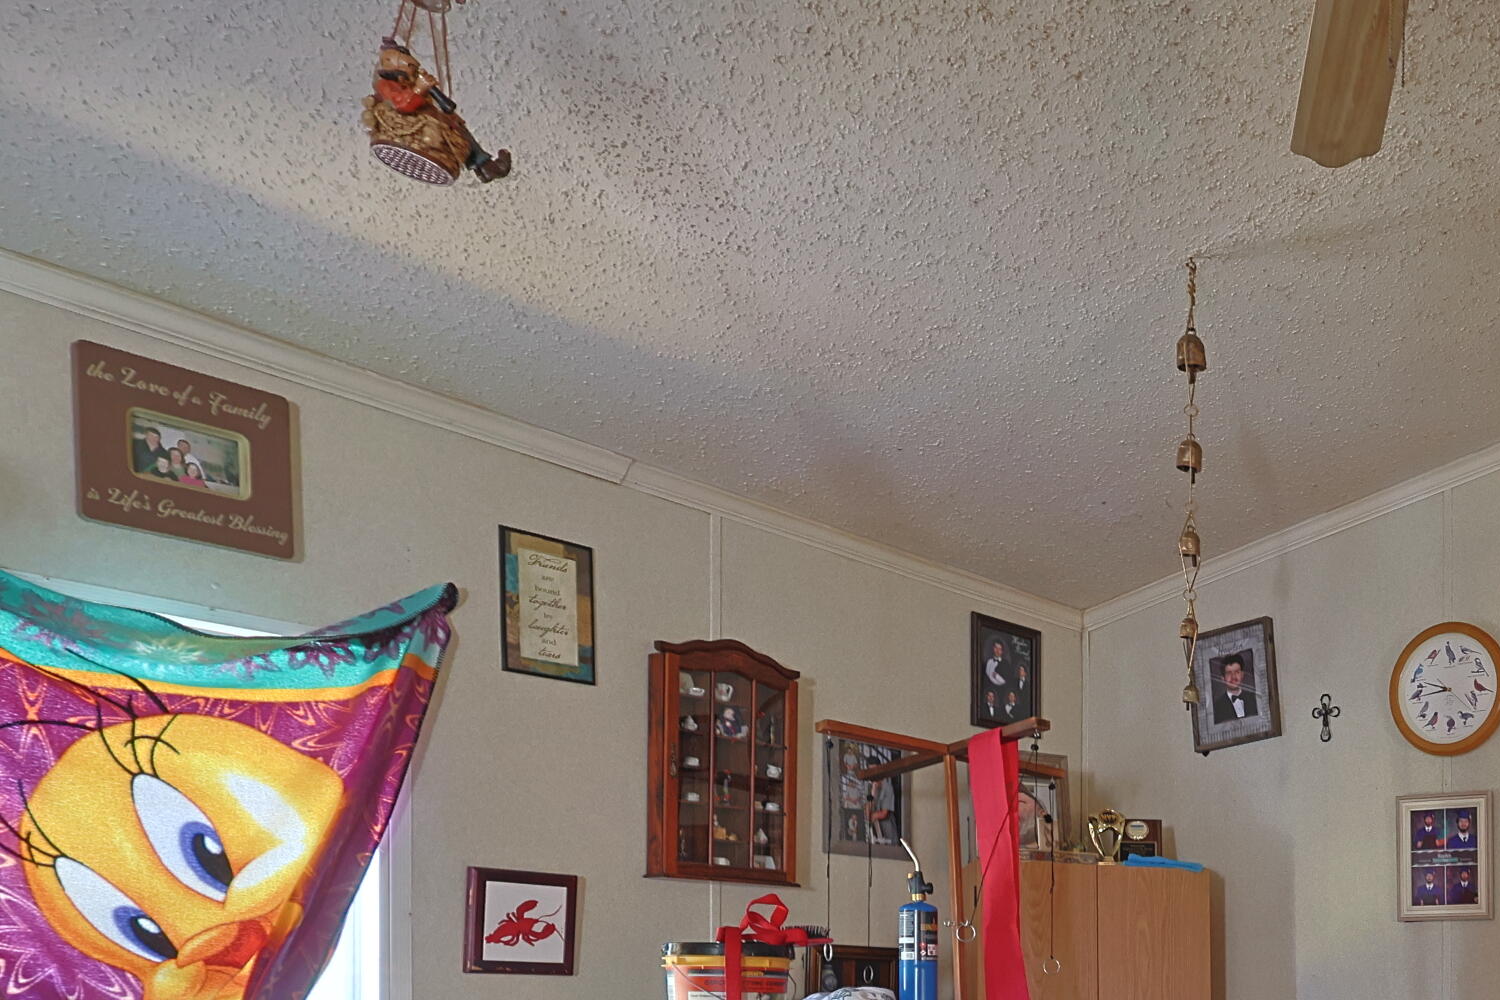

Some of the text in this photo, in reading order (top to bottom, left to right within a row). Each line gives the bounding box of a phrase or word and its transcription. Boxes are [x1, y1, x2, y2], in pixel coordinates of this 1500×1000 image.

[86, 361, 115, 381] the
[121, 367, 170, 396] Love
[208, 392, 272, 430] Family
[107, 487, 151, 512] Life's
[157, 499, 225, 526] Greatest
[228, 513, 289, 546] Blessing
